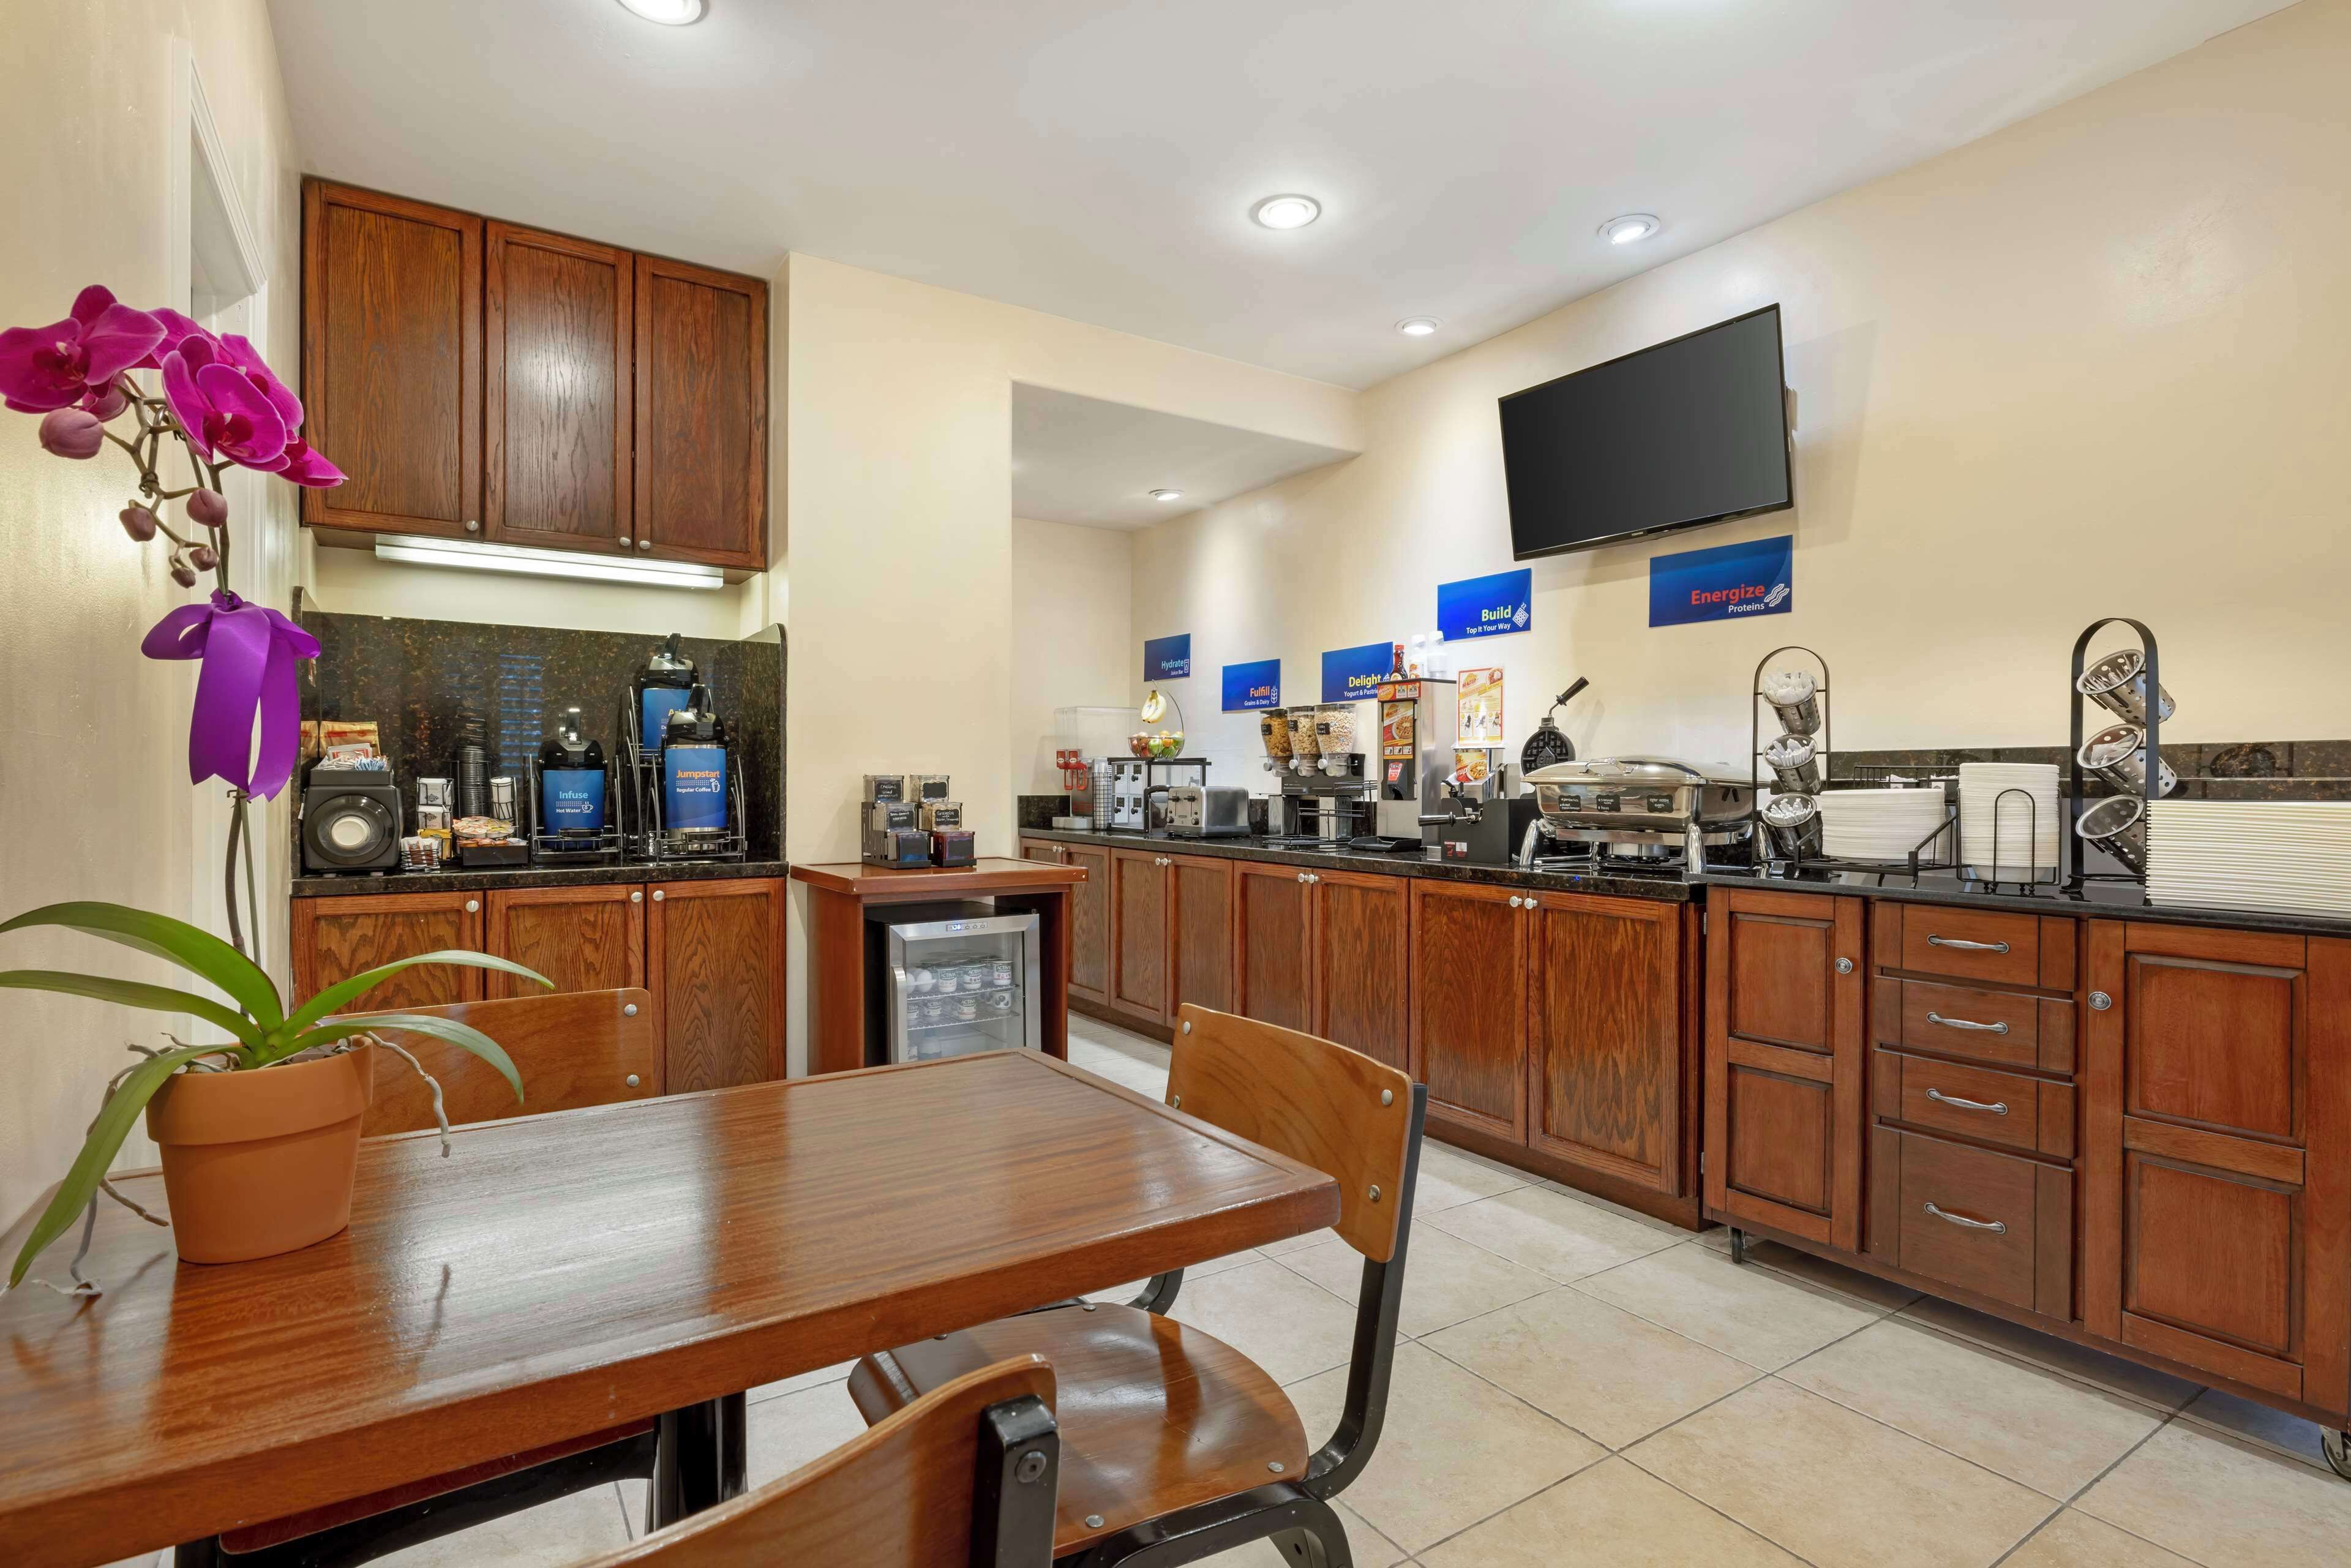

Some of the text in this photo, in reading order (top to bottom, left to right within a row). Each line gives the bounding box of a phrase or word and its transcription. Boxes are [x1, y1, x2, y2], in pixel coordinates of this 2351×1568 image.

[1691, 584, 1765, 605] Energize
[1482, 605, 1511, 621] Build
[1728, 602, 1764, 613] Proteins
[1161, 659, 1183, 670] Hydrate
[1349, 673, 1381, 688] Delight
[1250, 686, 1270, 697] Fulfill
[677, 770, 720, 779] Jumpstart
[559, 790, 588, 799] Infuse
